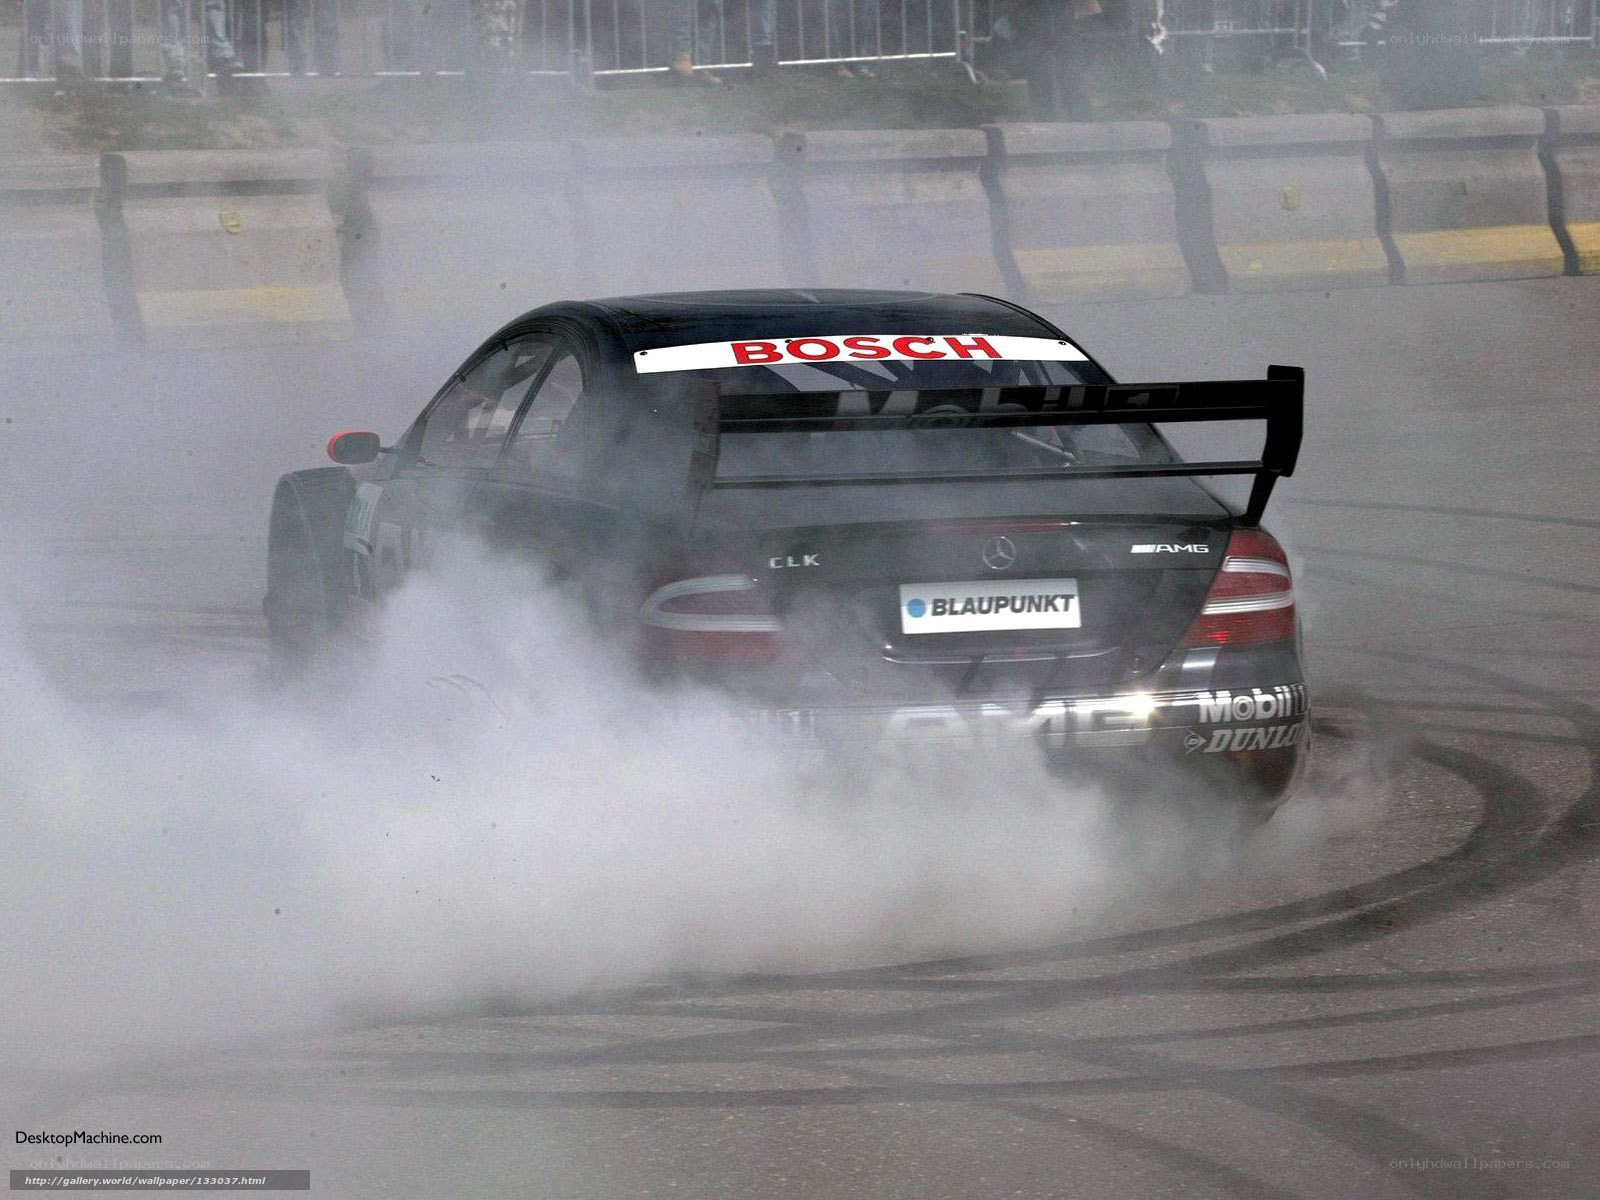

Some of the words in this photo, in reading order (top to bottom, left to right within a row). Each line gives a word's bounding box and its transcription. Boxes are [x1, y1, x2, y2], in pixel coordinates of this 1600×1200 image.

[730, 336, 1003, 365] BOSCH
[765, 553, 820, 569] CLK
[1155, 544, 1209, 554] AMG
[930, 593, 1075, 617] BLAUPUNKT
[1196, 685, 1291, 723] Mobil
